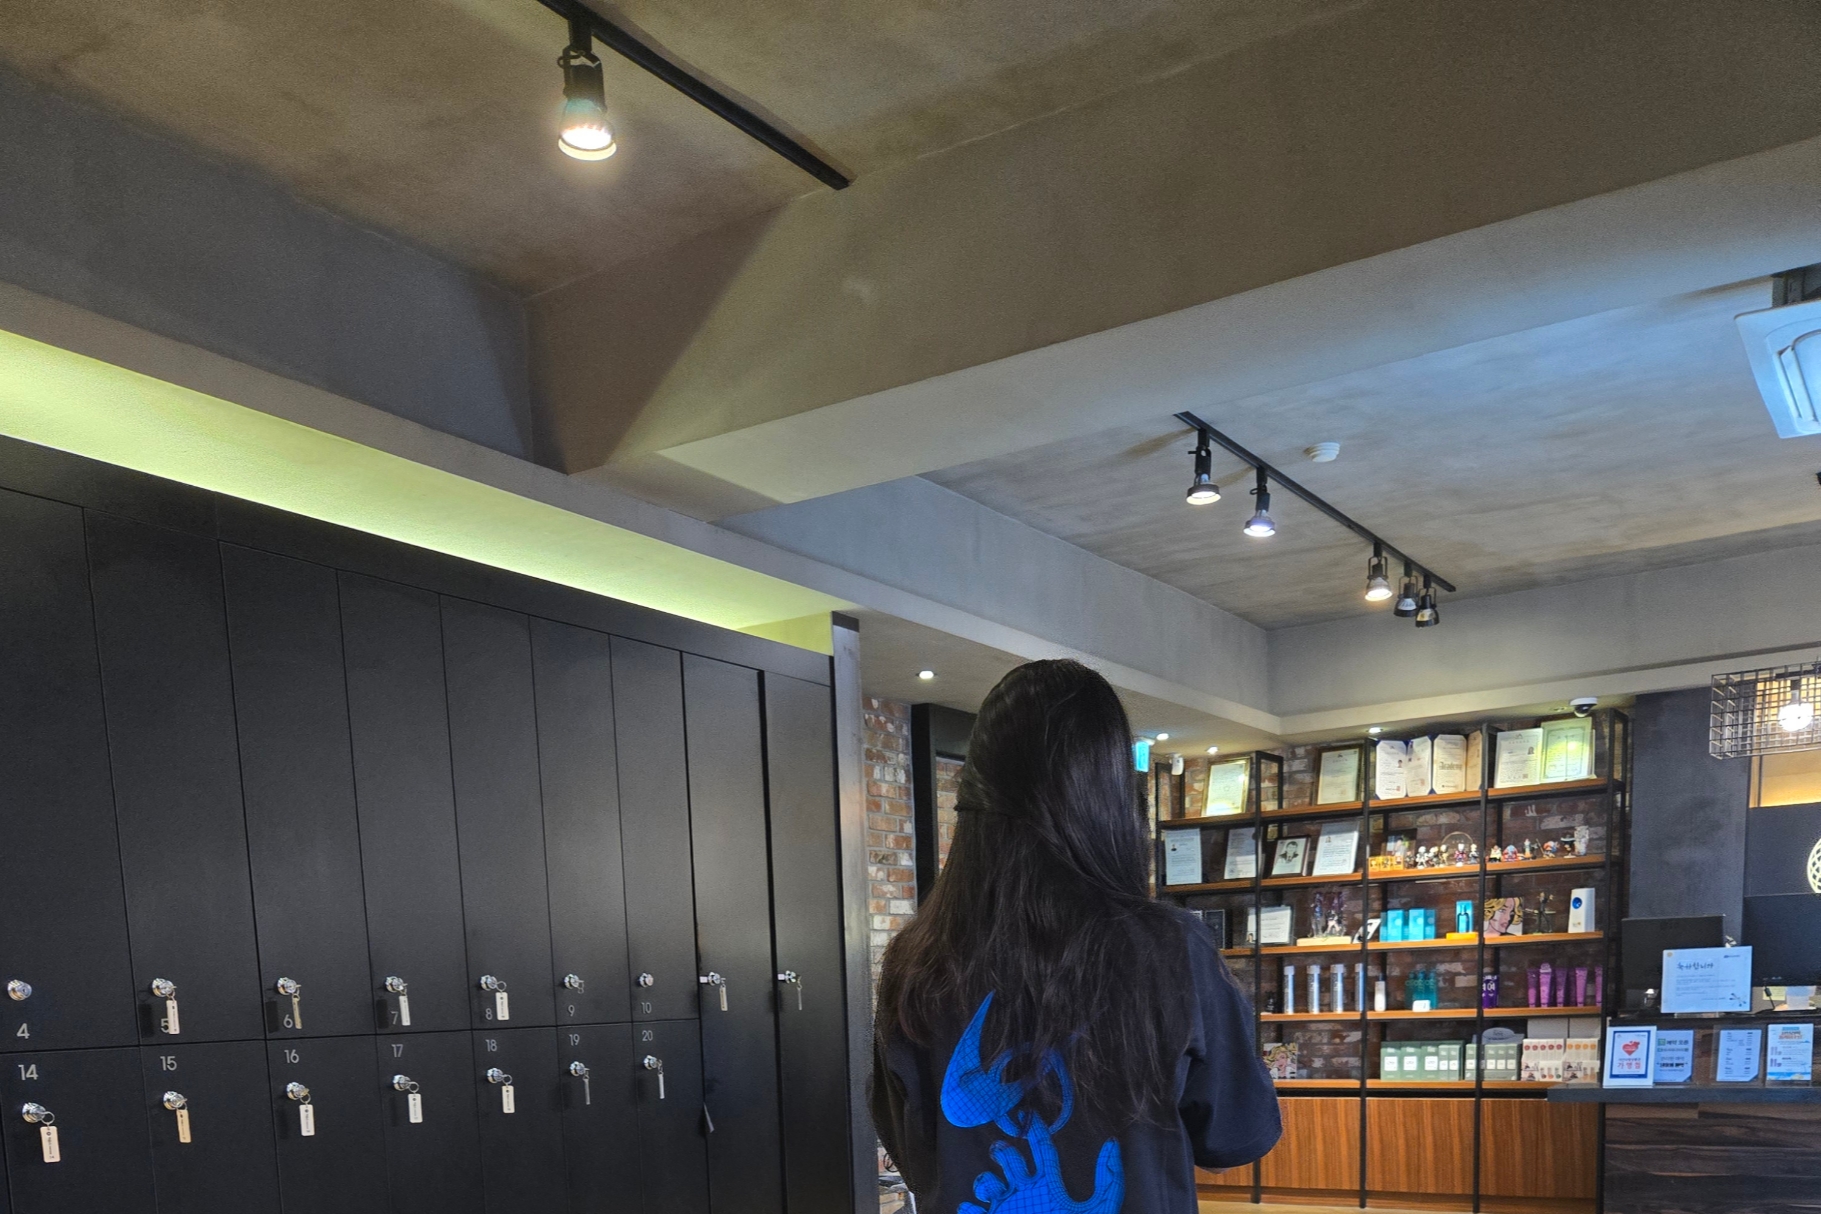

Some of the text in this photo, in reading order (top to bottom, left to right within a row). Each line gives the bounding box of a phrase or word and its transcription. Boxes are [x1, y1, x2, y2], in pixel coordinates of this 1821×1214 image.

[485, 1008, 492, 1020] 8
[567, 1005, 575, 1017] 9
[641, 1002, 652, 1014] 10
[283, 1014, 293, 1029] 6
[390, 1011, 398, 1024] 7
[16, 1023, 30, 1039] 4
[160, 1016, 169, 1033] 5
[568, 1034, 580, 1046] 19
[641, 1030, 653, 1042] 20
[391, 1044, 403, 1057] 17
[485, 1039, 497, 1052] 18
[284, 1049, 299, 1063] 16
[159, 1056, 177, 1071] 15
[17, 1064, 38, 1081] 14
